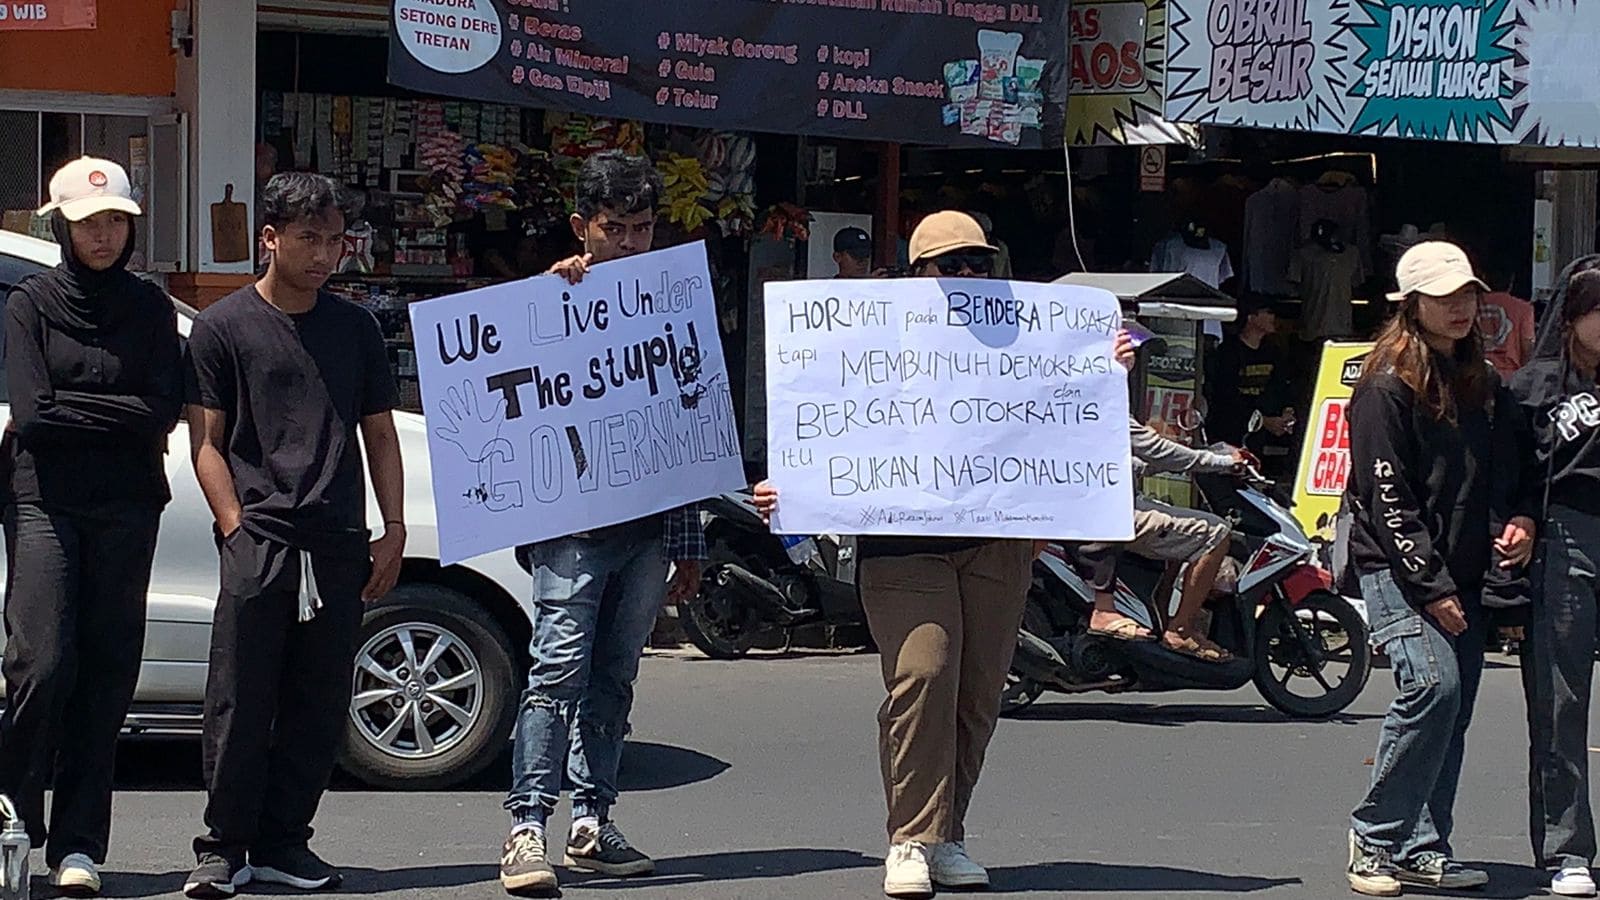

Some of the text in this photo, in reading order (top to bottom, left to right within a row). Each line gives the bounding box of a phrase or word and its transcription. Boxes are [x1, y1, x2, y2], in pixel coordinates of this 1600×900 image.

[13, 4, 47, 20] WIB
[400, 8, 499, 35] SETONG DERE
[524, 15, 583, 41] Beras
[1010, 3, 1043, 23] DLL
[1207, 0, 1312, 46] OBRAL
[414, 30, 471, 51] TRETAN
[1386, 4, 1482, 60] DISKON
[526, 42, 552, 63] Air
[554, 47, 629, 74] Mineral
[658, 32, 798, 65] # Miyak Goreng
[817, 44, 870, 70] # kopi
[511, 65, 525, 84] #
[528, 68, 564, 90] Gas
[658, 59, 716, 82] # Gula
[817, 71, 945, 99] # Aneka Snack
[1208, 42, 1316, 103] BESAR
[1364, 60, 1502, 99] SEMUA HARGA
[655, 86, 719, 110] # Telur
[817, 99, 868, 119] # DLL
[436, 269, 703, 365] We Live Under
[789, 291, 1120, 337] HORMAT pada BENDERA PUSAKA
[486, 320, 703, 421] The stupid
[777, 344, 1113, 388] tapi MEMBUNUH DEMOKRASI
[1053, 382, 1082, 401] dan
[796, 397, 1100, 441] BERGAYA OTOKRATIS
[476, 380, 741, 513] GOVERNMENT
[828, 455, 1120, 496] BUKAN NASIONALISME
